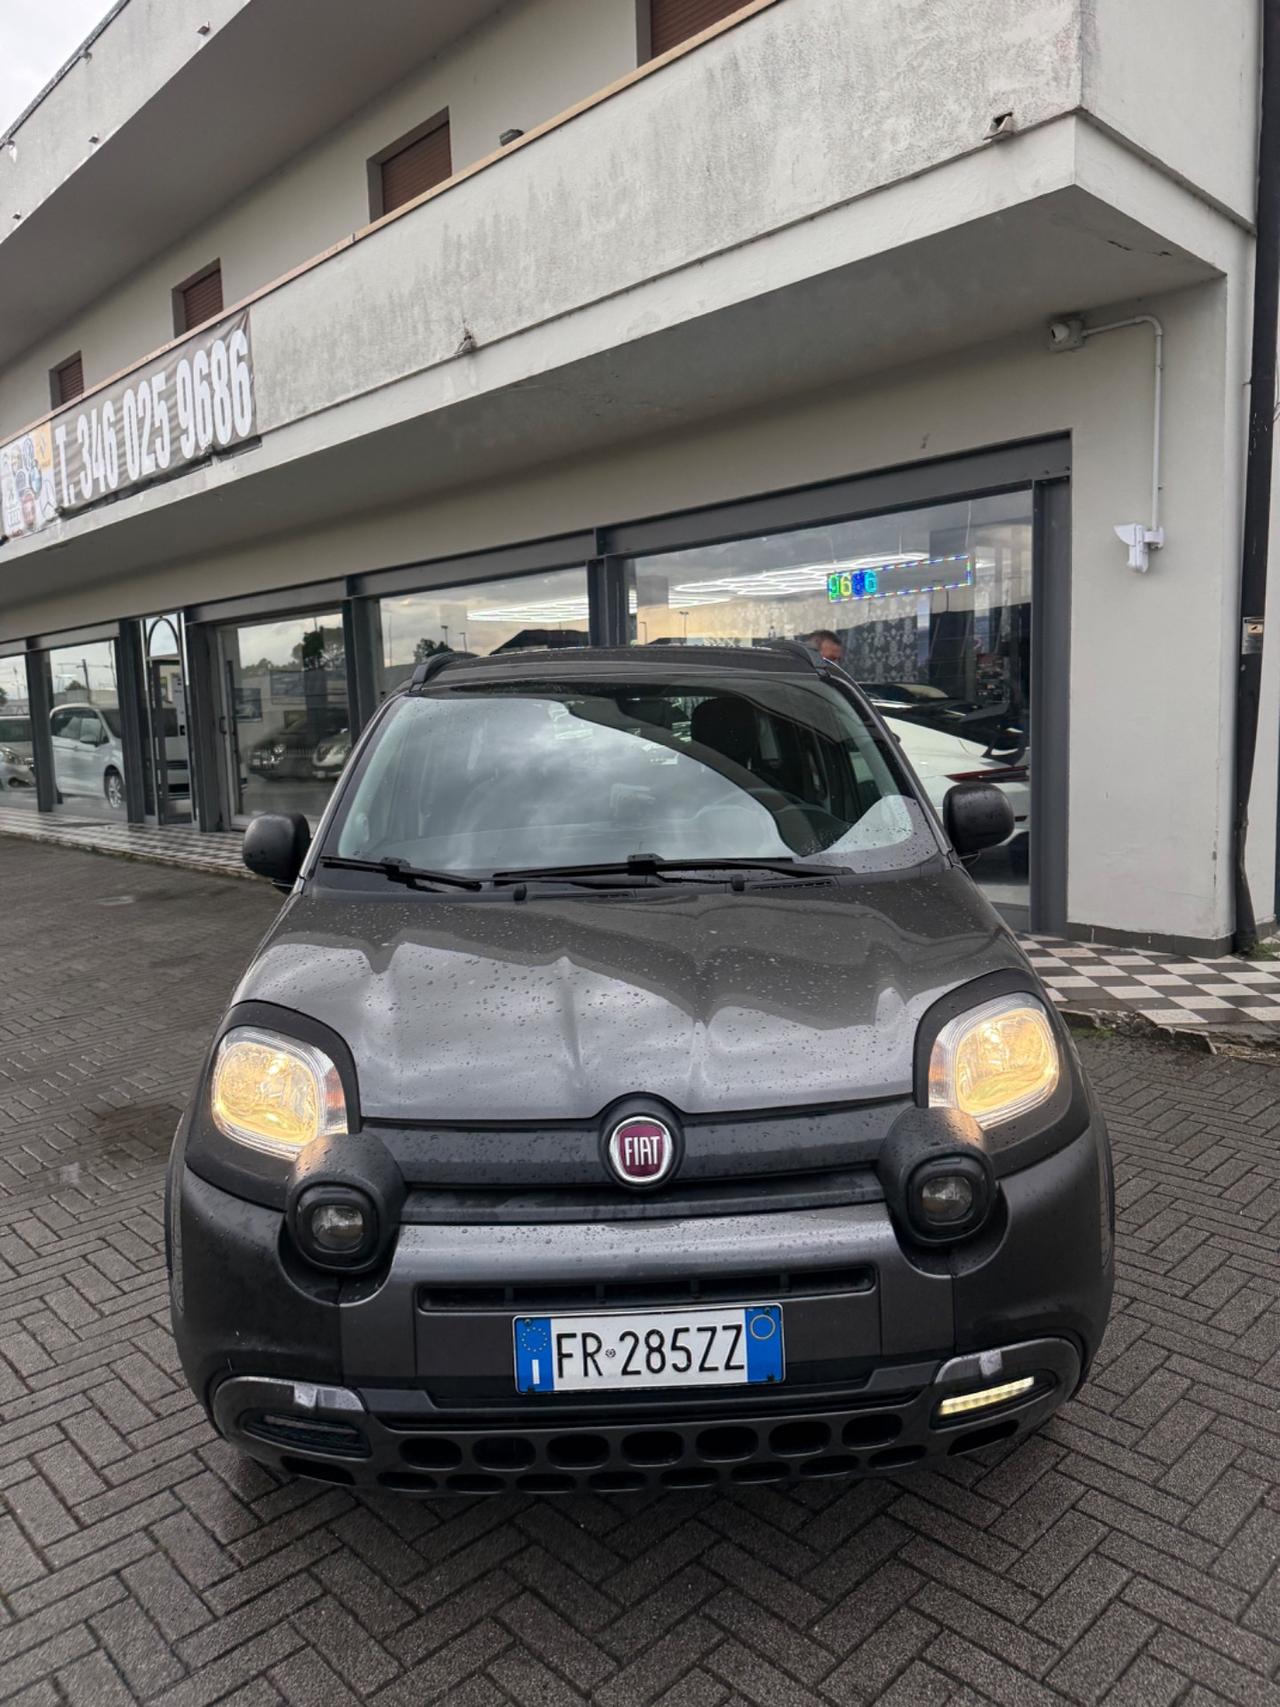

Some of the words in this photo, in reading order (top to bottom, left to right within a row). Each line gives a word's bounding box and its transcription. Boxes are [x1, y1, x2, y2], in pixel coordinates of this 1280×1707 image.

[77, 400, 119, 500] 346
[123, 371, 171, 481] 025
[176, 328, 252, 459] 9686
[624, 1136, 660, 1166] FIAT
[556, 1332, 603, 1378] FR
